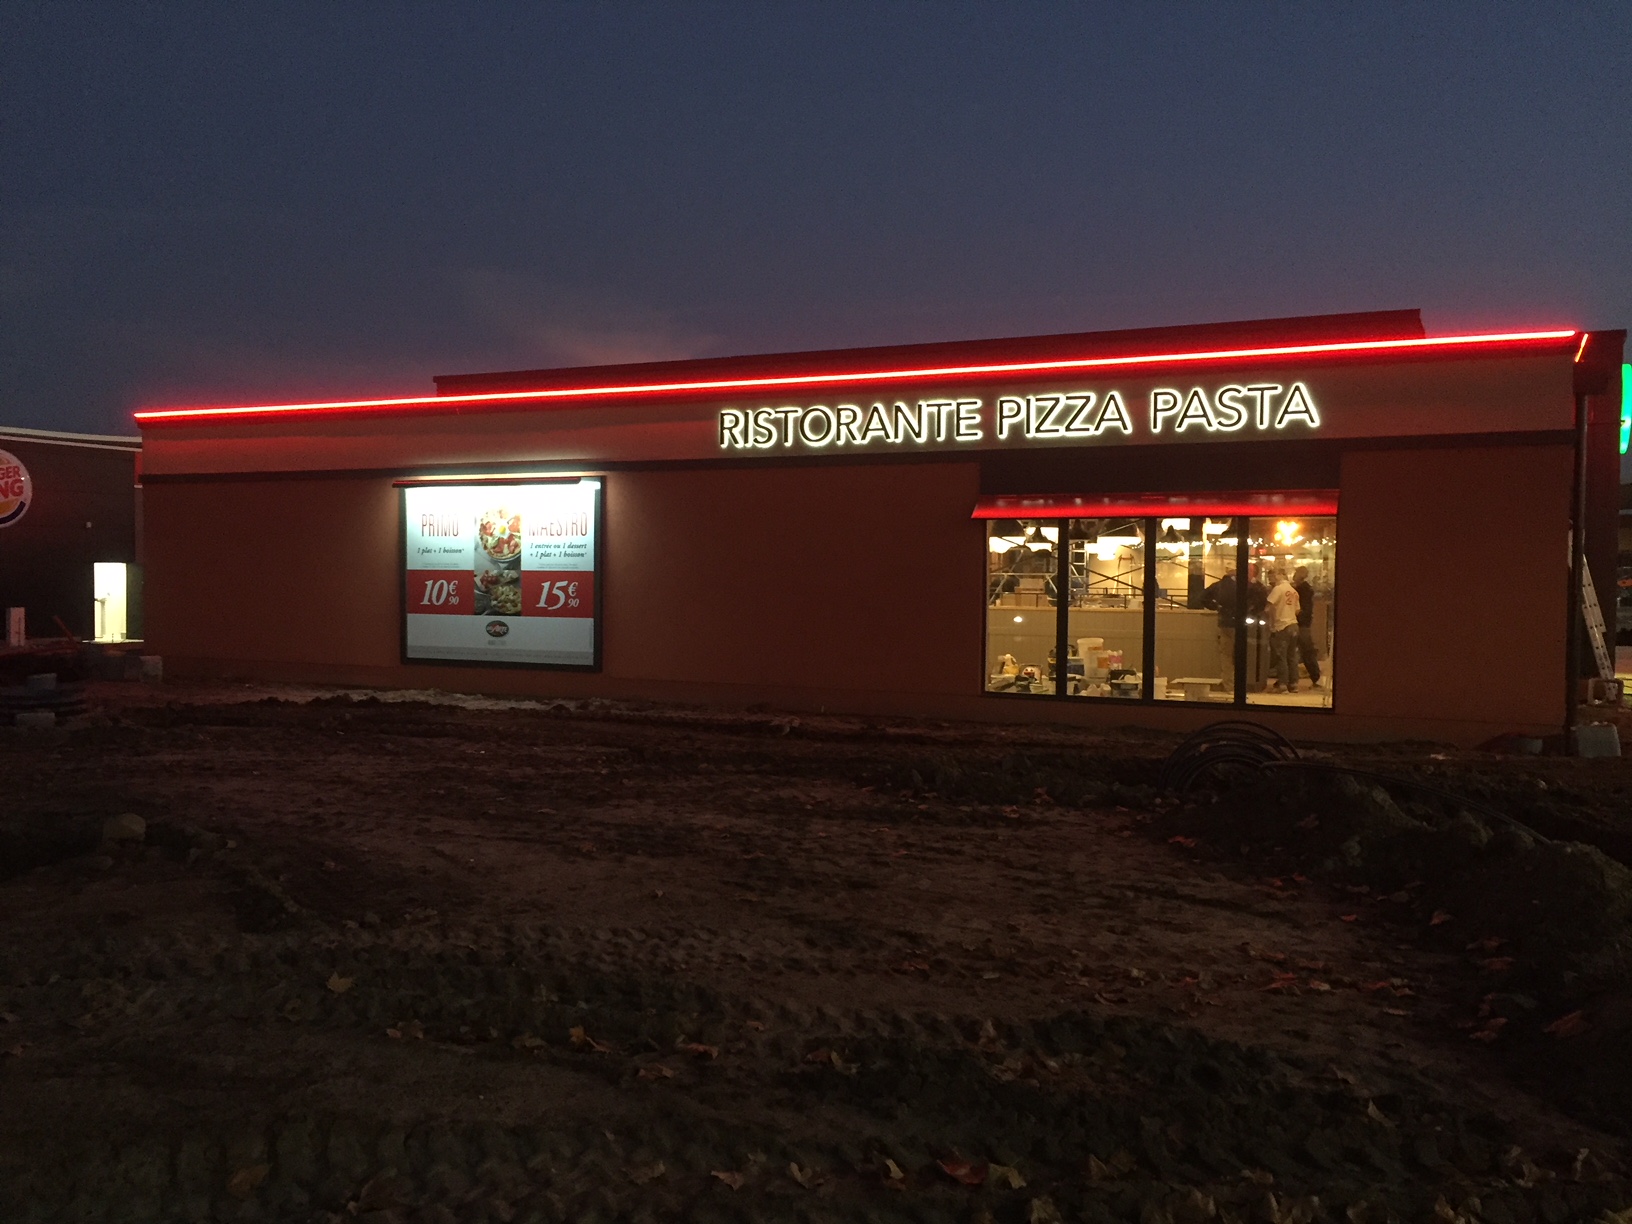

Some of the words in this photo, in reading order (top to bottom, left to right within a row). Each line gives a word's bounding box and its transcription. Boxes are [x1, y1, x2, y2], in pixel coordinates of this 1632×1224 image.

[719, 398, 982, 449] RISTORANTE
[997, 390, 1133, 439] PIZZA
[1150, 382, 1321, 433] PASTA
[421, 513, 459, 537] PRIMO
[528, 511, 588, 537] MAESTRO
[422, 547, 433, 555] plat
[567, 541, 588, 549] dessert
[539, 551, 552, 560] plat
